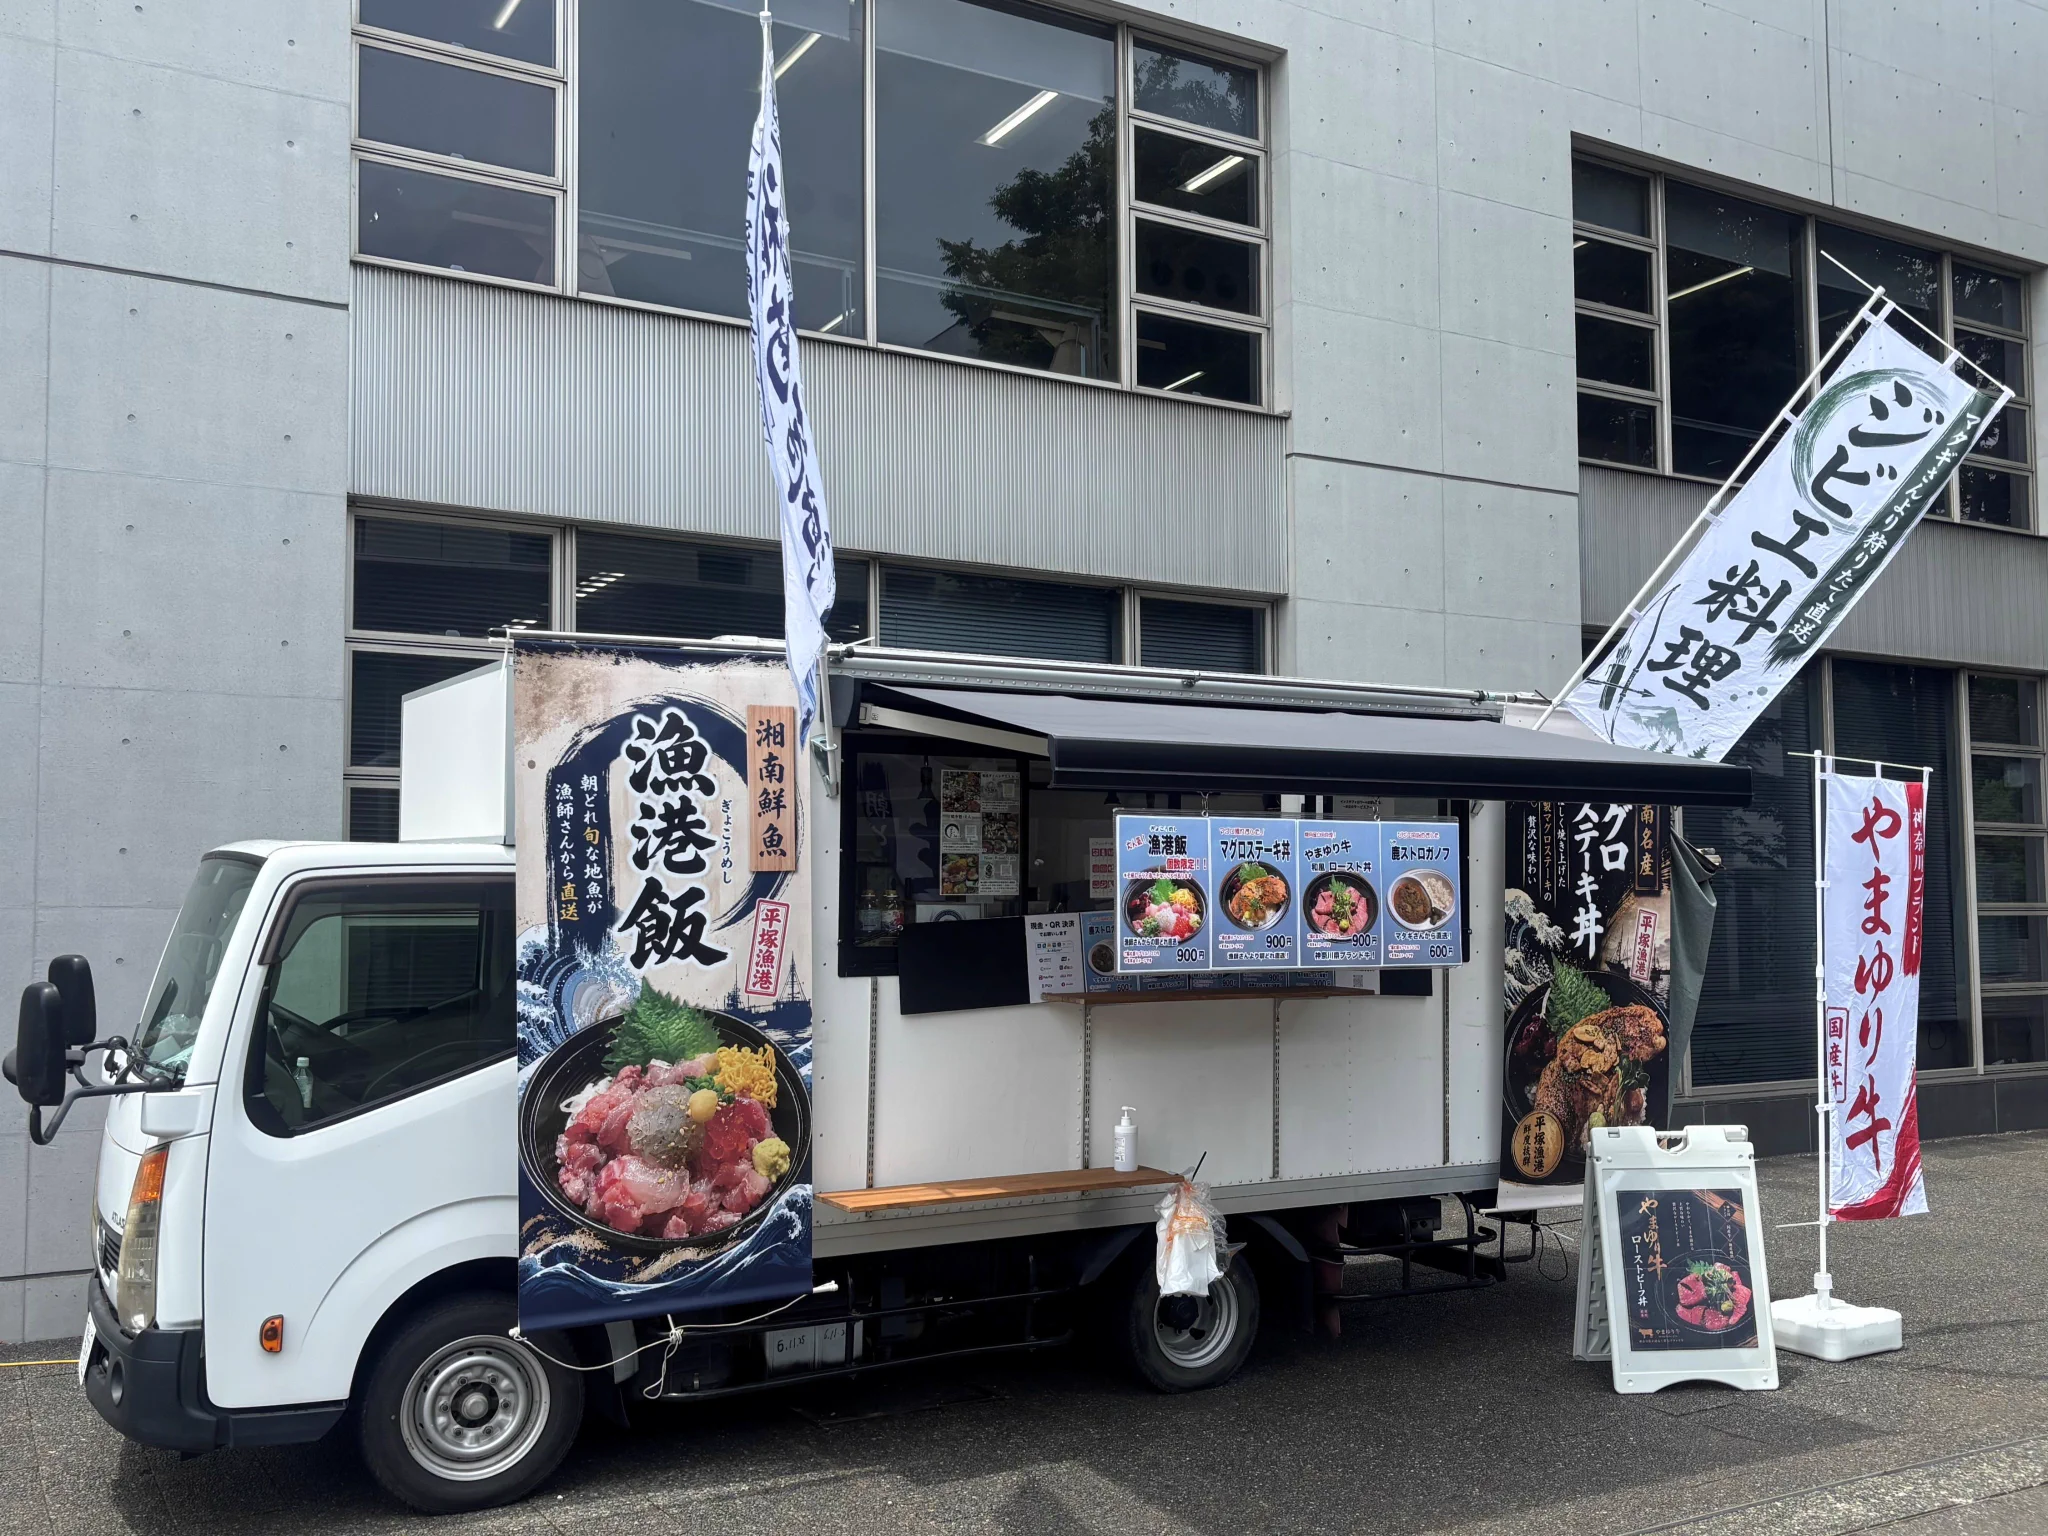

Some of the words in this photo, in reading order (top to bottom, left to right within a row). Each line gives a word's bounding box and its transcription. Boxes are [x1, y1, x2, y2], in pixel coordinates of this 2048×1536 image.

[1647, 379, 1945, 712] ジビエ料理
[1788, 412, 1982, 645] マタギさんより狩りたて直送
[755, 719, 787, 859] 湘南鮮魚
[554, 782, 581, 922] 漁師さんから直送
[579, 773, 604, 915] 朝どれ旬な地魚が
[616, 710, 729, 971] 漁港飯
[720, 798, 734, 885] ぎょこうめし
[1148, 834, 1188, 856] 漁港飯
[1220, 839, 1291, 861] マグロステーキ丼
[1304, 839, 1352, 861] やまゆり牛
[1311, 863, 1326, 871] 和風
[1329, 862, 1373, 872] ロースト丼
[1391, 845, 1451, 861] 鹿ストロガノフ
[750, 906, 784, 991] 平塚漁港
[1176, 948, 1206, 962] 900円
[1265, 934, 1292, 949] 900円
[1352, 933, 1377, 947] 900円
[1429, 944, 1454, 958] 600円
[1635, 914, 1654, 977] 平塚漁港
[1846, 796, 1902, 1173] やまゆり牛
[1828, 1016, 1844, 1097] 国産牛
[1533, 1115, 1546, 1173] 平塚漁港
[1631, 1235, 1649, 1308] ローストビーフ丼
[1638, 1197, 1668, 1282] やまゆり牛
